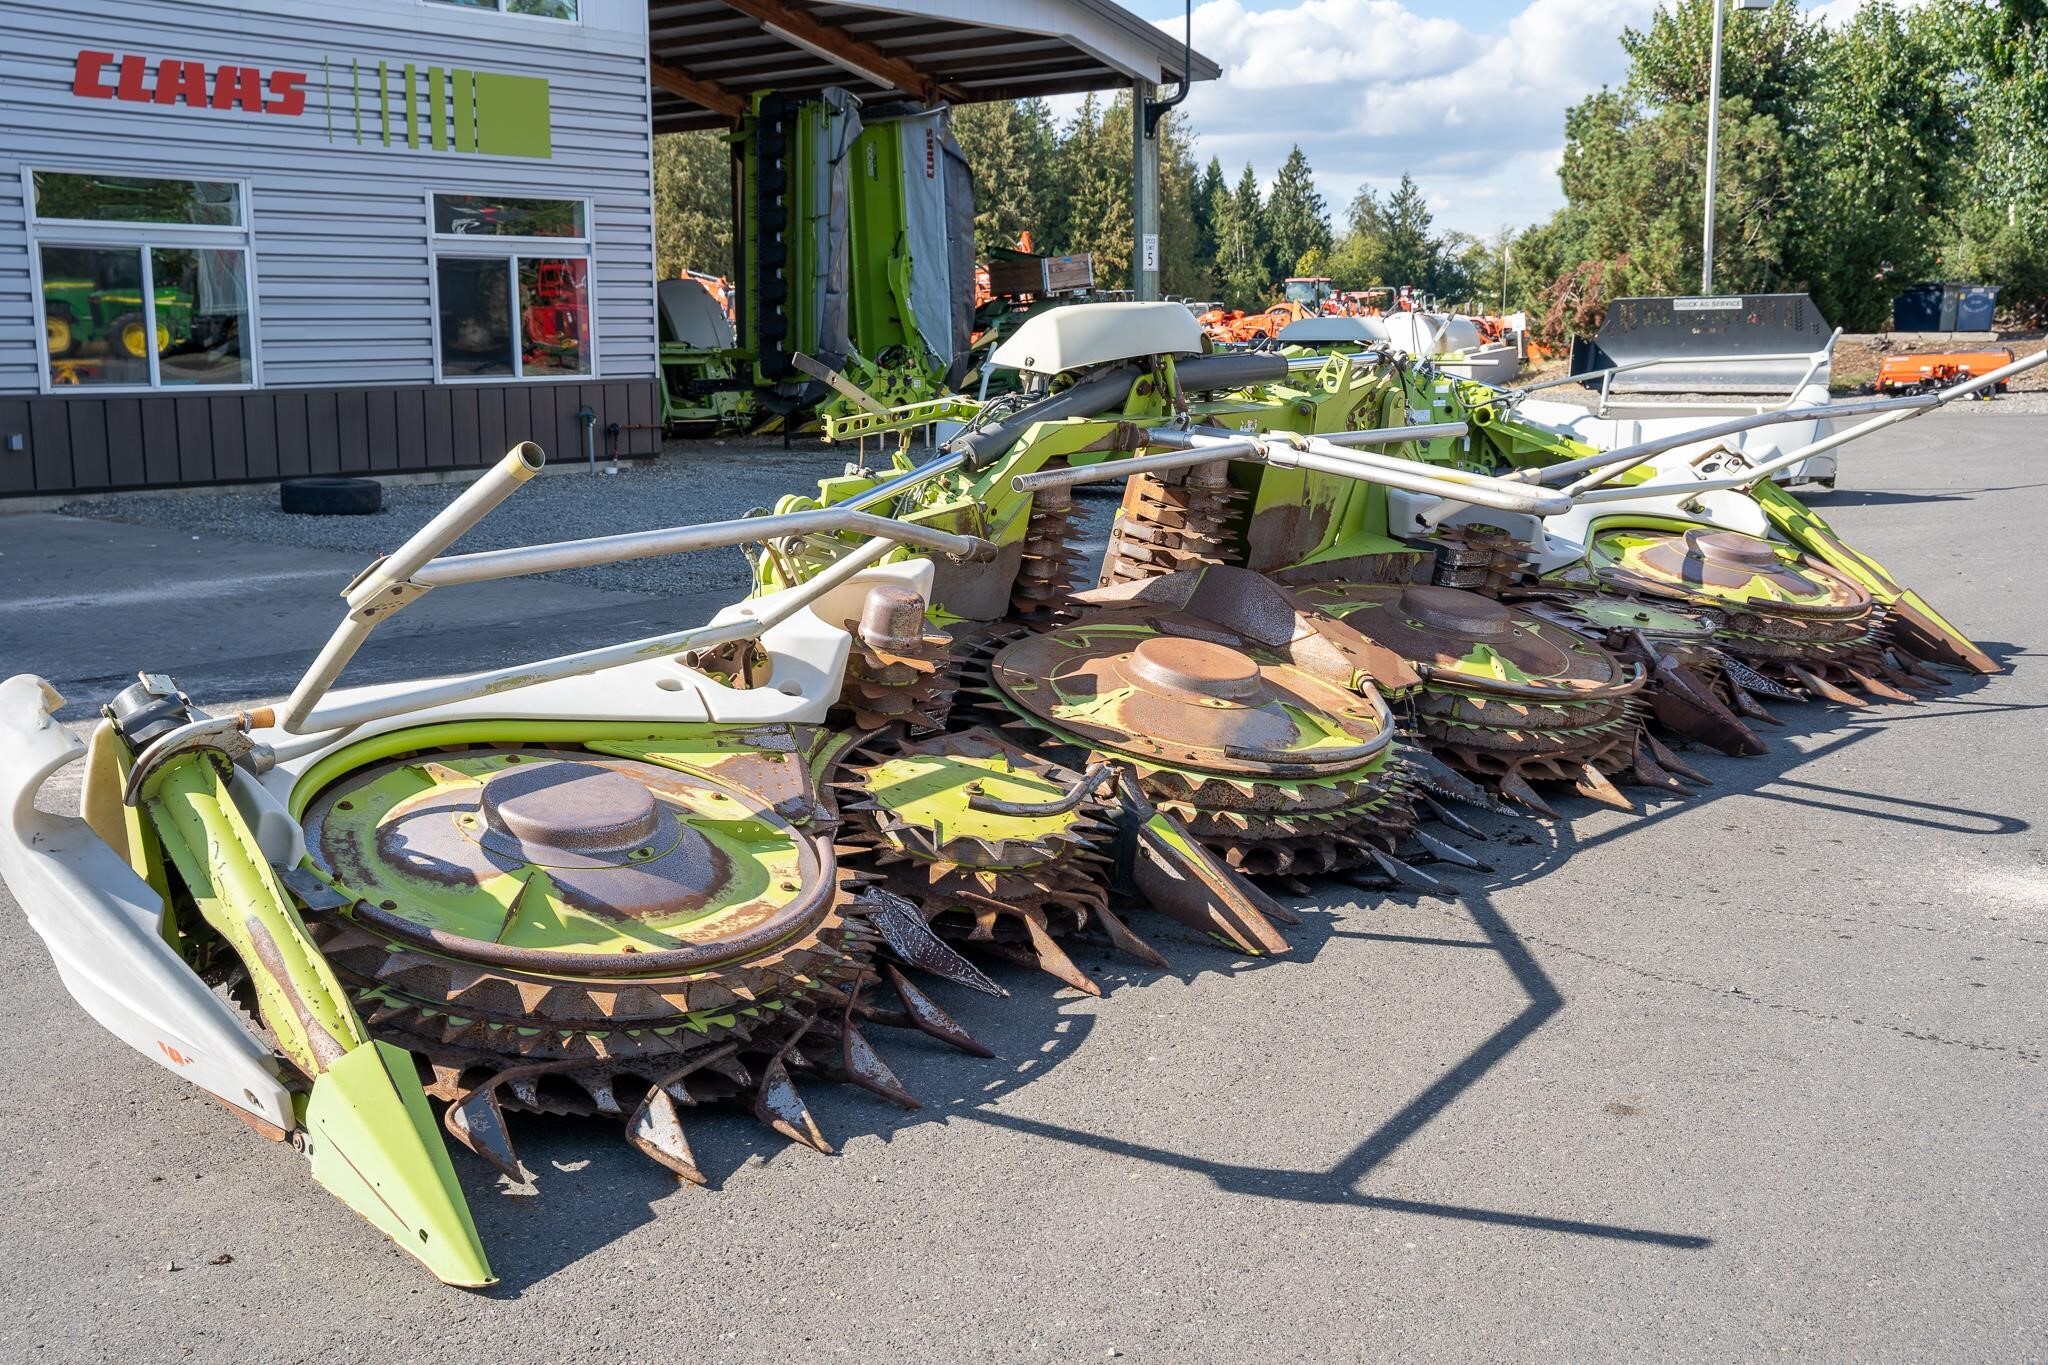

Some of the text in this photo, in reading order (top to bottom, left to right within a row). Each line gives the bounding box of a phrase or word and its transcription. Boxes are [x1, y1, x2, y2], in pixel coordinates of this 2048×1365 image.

[73, 50, 307, 116] CLAAS
[926, 128, 934, 179] CLAAS
[1148, 252, 1153, 266] 5
